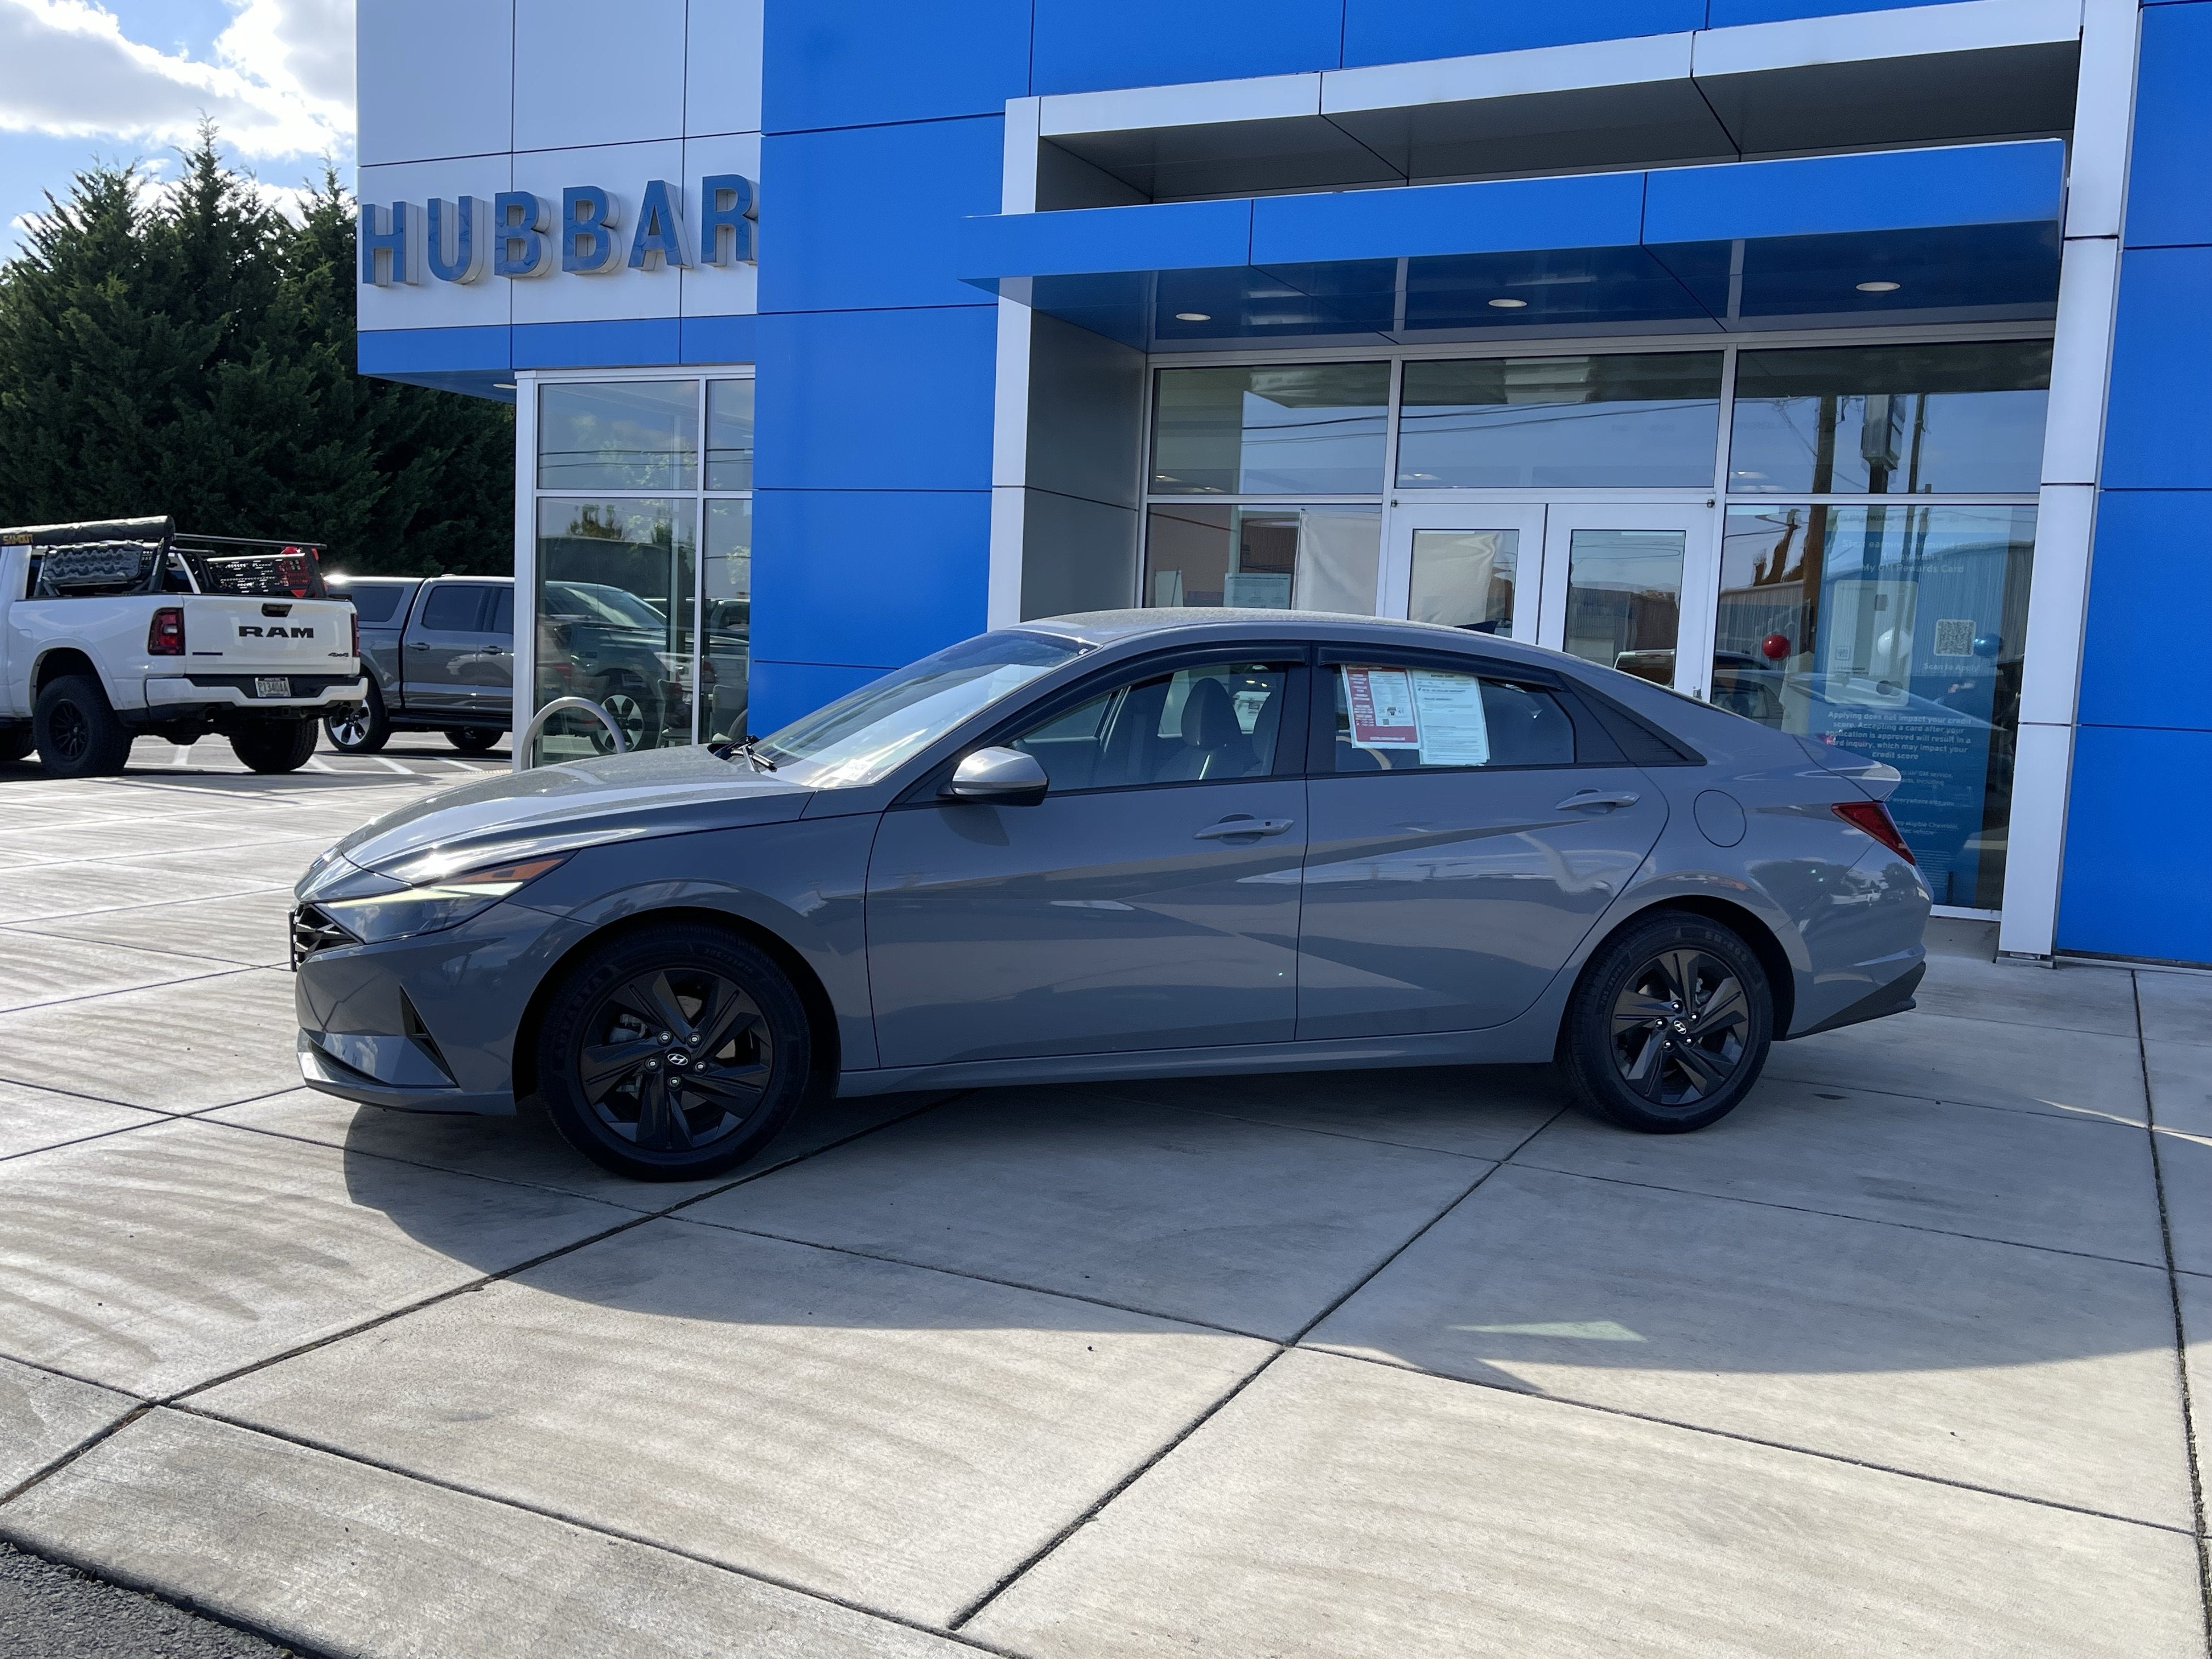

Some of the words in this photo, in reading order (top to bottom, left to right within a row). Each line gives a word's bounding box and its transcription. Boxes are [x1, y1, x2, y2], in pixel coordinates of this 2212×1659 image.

[1883, 552, 1909, 561] today
[1863, 563, 1876, 573] My
[1896, 564, 1938, 573] Rewards
[1940, 565, 1965, 573] Card
[239, 626, 314, 638] RAM
[1924, 663, 1942, 671] Scan
[1828, 711, 1862, 720] Applying
[1858, 722, 1897, 731] Accepting
